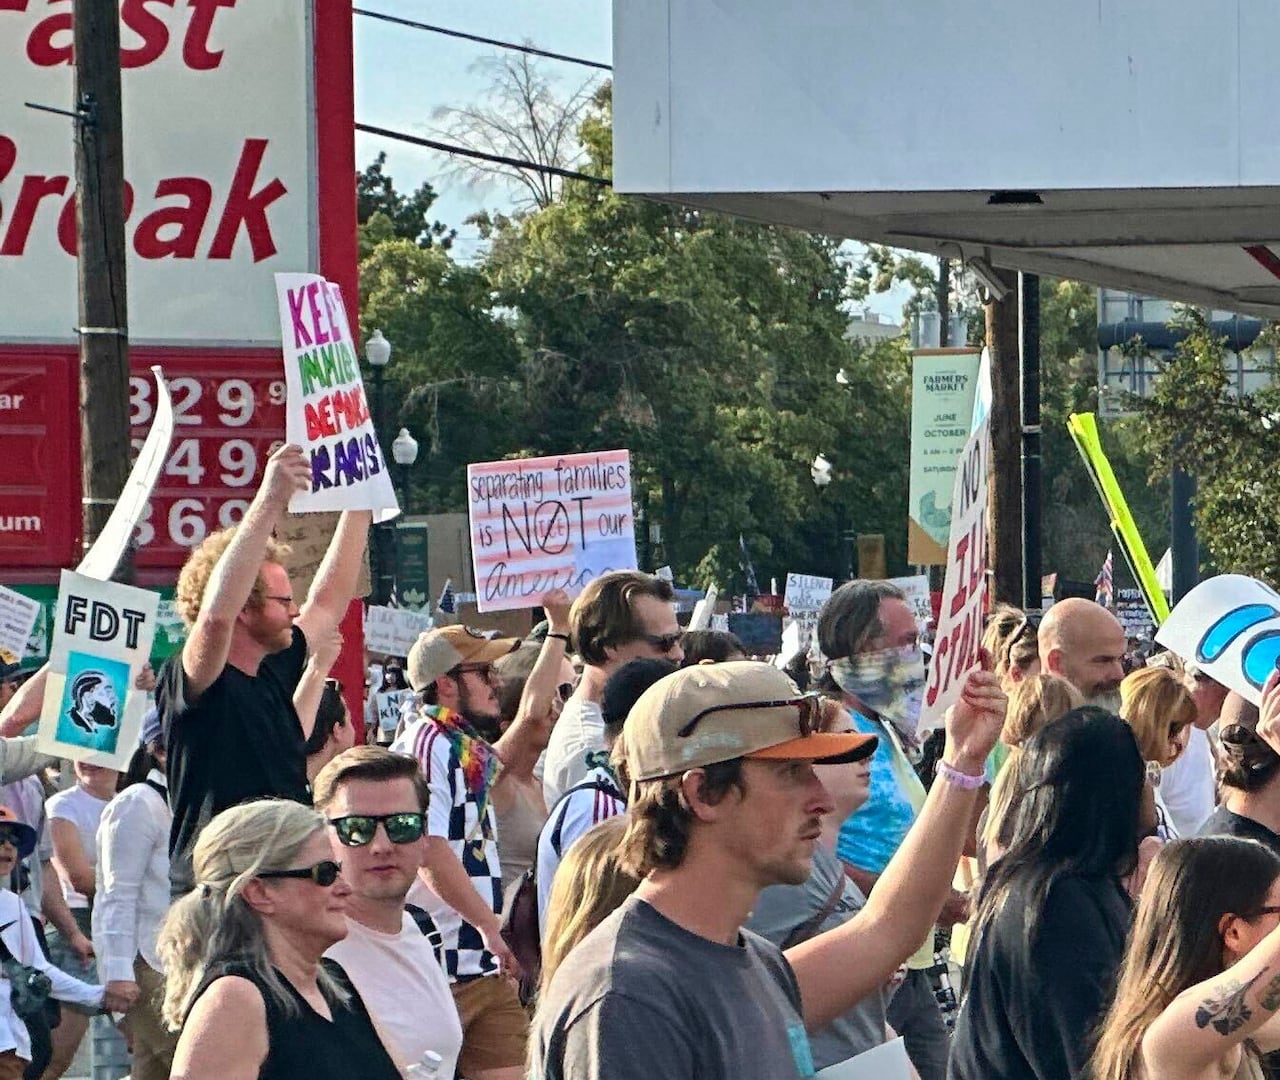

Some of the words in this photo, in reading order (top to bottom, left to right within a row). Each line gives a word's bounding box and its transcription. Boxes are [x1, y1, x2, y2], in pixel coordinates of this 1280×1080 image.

[0, 0, 236, 70] ast
[0, 135, 288, 263] rak
[923, 375, 969, 385] FARMERS
[925, 383, 965, 392] MARKET
[924, 429, 966, 438] OCTOBER
[131, 438, 257, 487] 49
[310, 432, 388, 493] RACIS
[471, 466, 543, 513] separating
[554, 459, 625, 496] families
[479, 524, 494, 549] is
[502, 496, 593, 559] NOT
[598, 512, 627, 536] our
[65, 594, 146, 650] FDT
